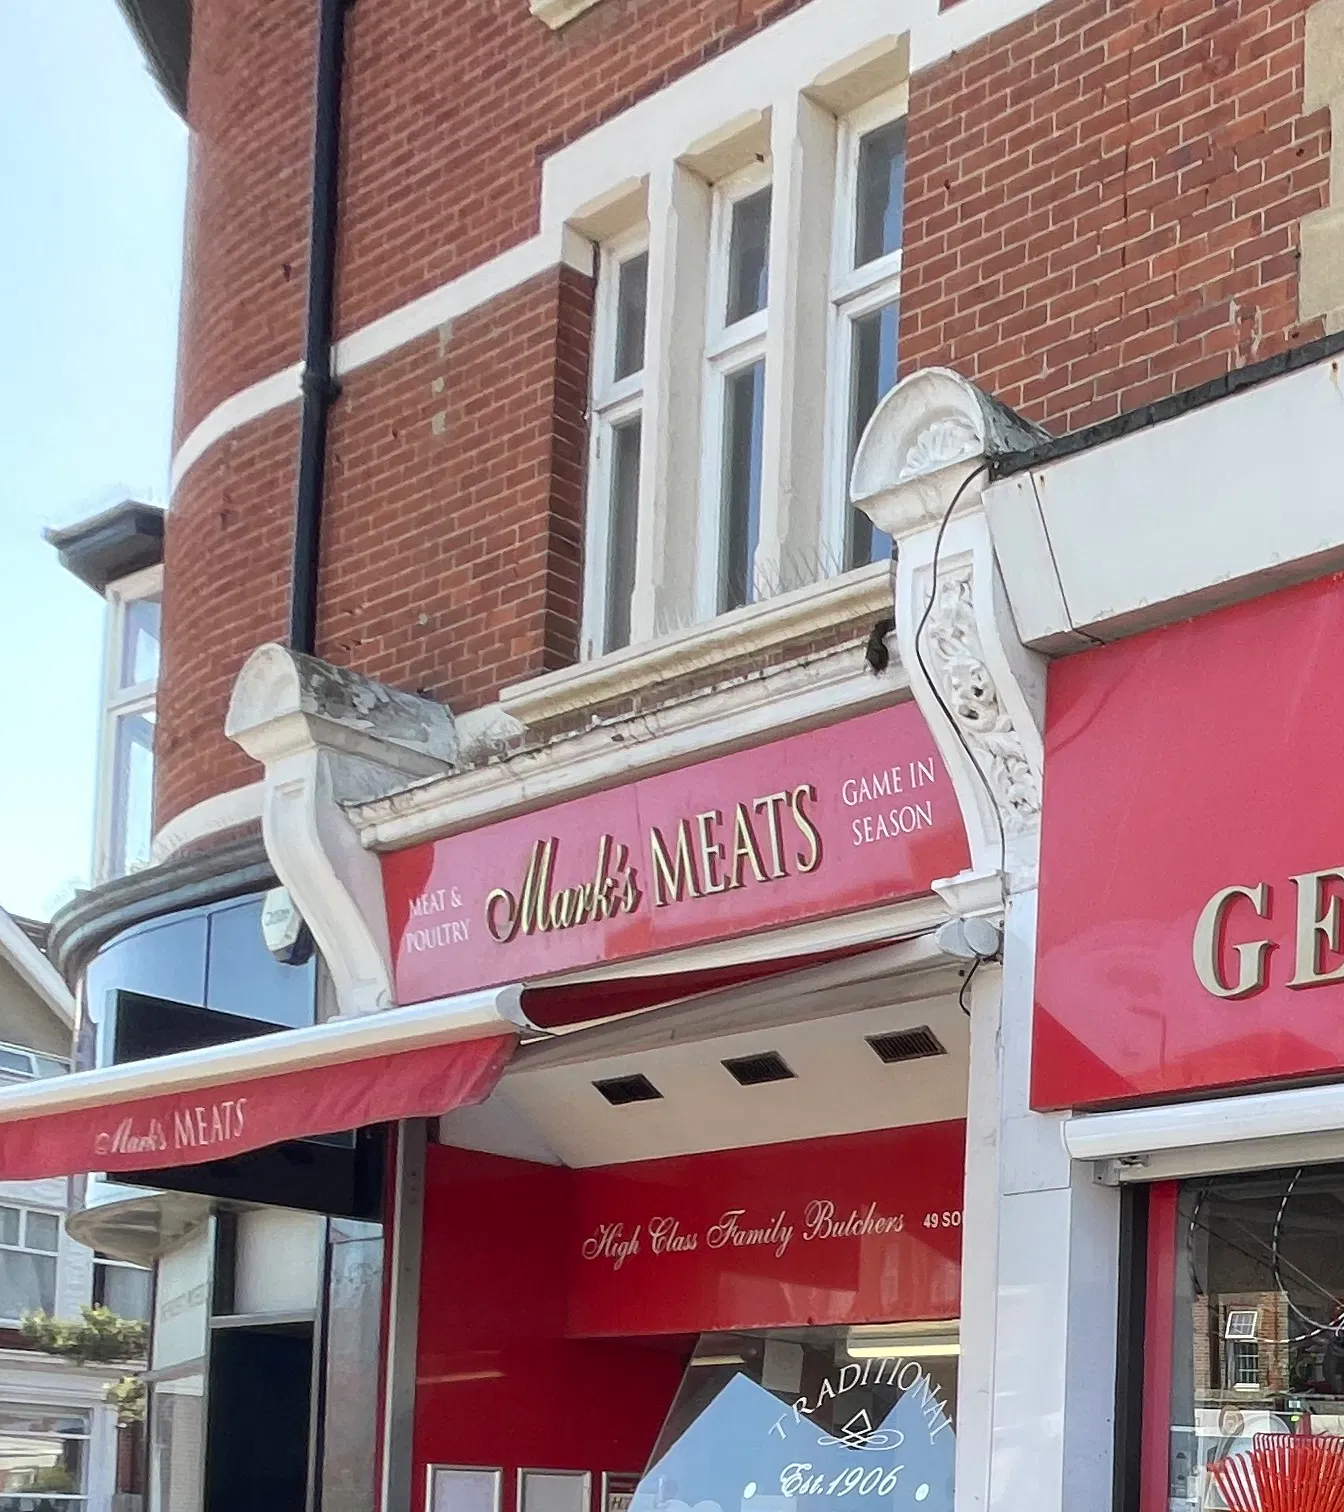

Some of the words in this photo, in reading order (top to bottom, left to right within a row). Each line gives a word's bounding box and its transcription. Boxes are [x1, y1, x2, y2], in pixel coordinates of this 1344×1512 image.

[841, 766, 904, 807] GAME
[910, 757, 936, 789] IN
[851, 801, 934, 847] SEASON
[485, 833, 643, 943] Mark's
[649, 784, 823, 909] MEATS
[409, 894, 448, 919] MEAT
[450, 889, 464, 907] &
[405, 919, 472, 953] POULTRY
[95, 1117, 168, 1155] Mark's
[174, 1097, 249, 1149] MEATS
[581, 1223, 641, 1271] High
[647, 1216, 698, 1255] Class
[706, 1208, 795, 1259] Family
[803, 1199, 905, 1242] Butchers
[923, 1212, 939, 1229] 49
[767, 1357, 955, 1446] TRADITIONAL
